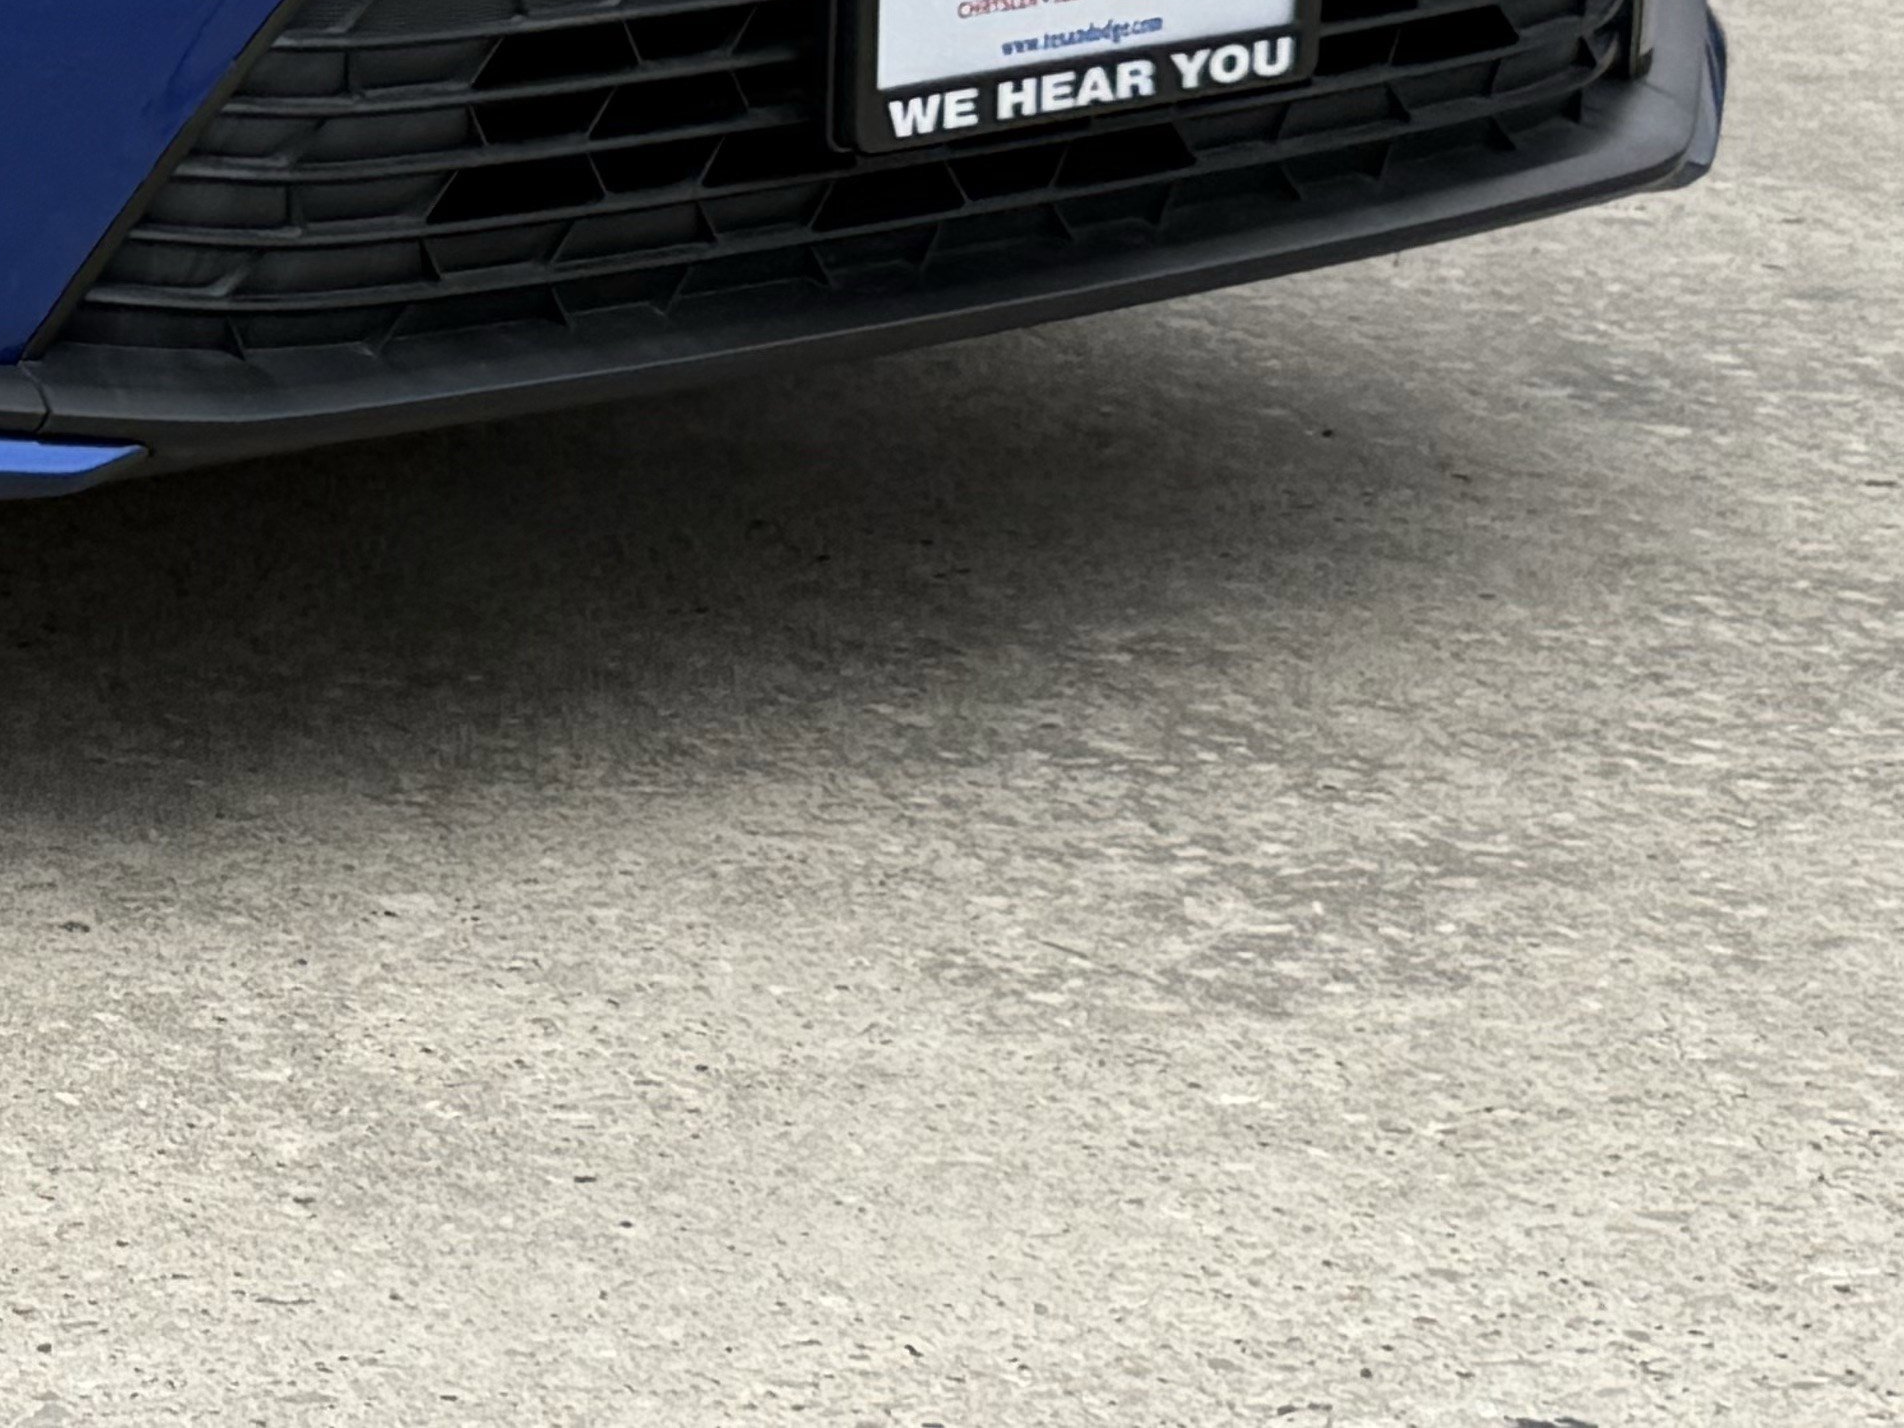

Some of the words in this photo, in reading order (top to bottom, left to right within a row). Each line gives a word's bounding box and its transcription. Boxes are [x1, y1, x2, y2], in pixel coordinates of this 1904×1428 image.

[888, 87, 979, 138] WE
[996, 59, 1157, 121] HEAR
[1170, 36, 1294, 89] YOU
